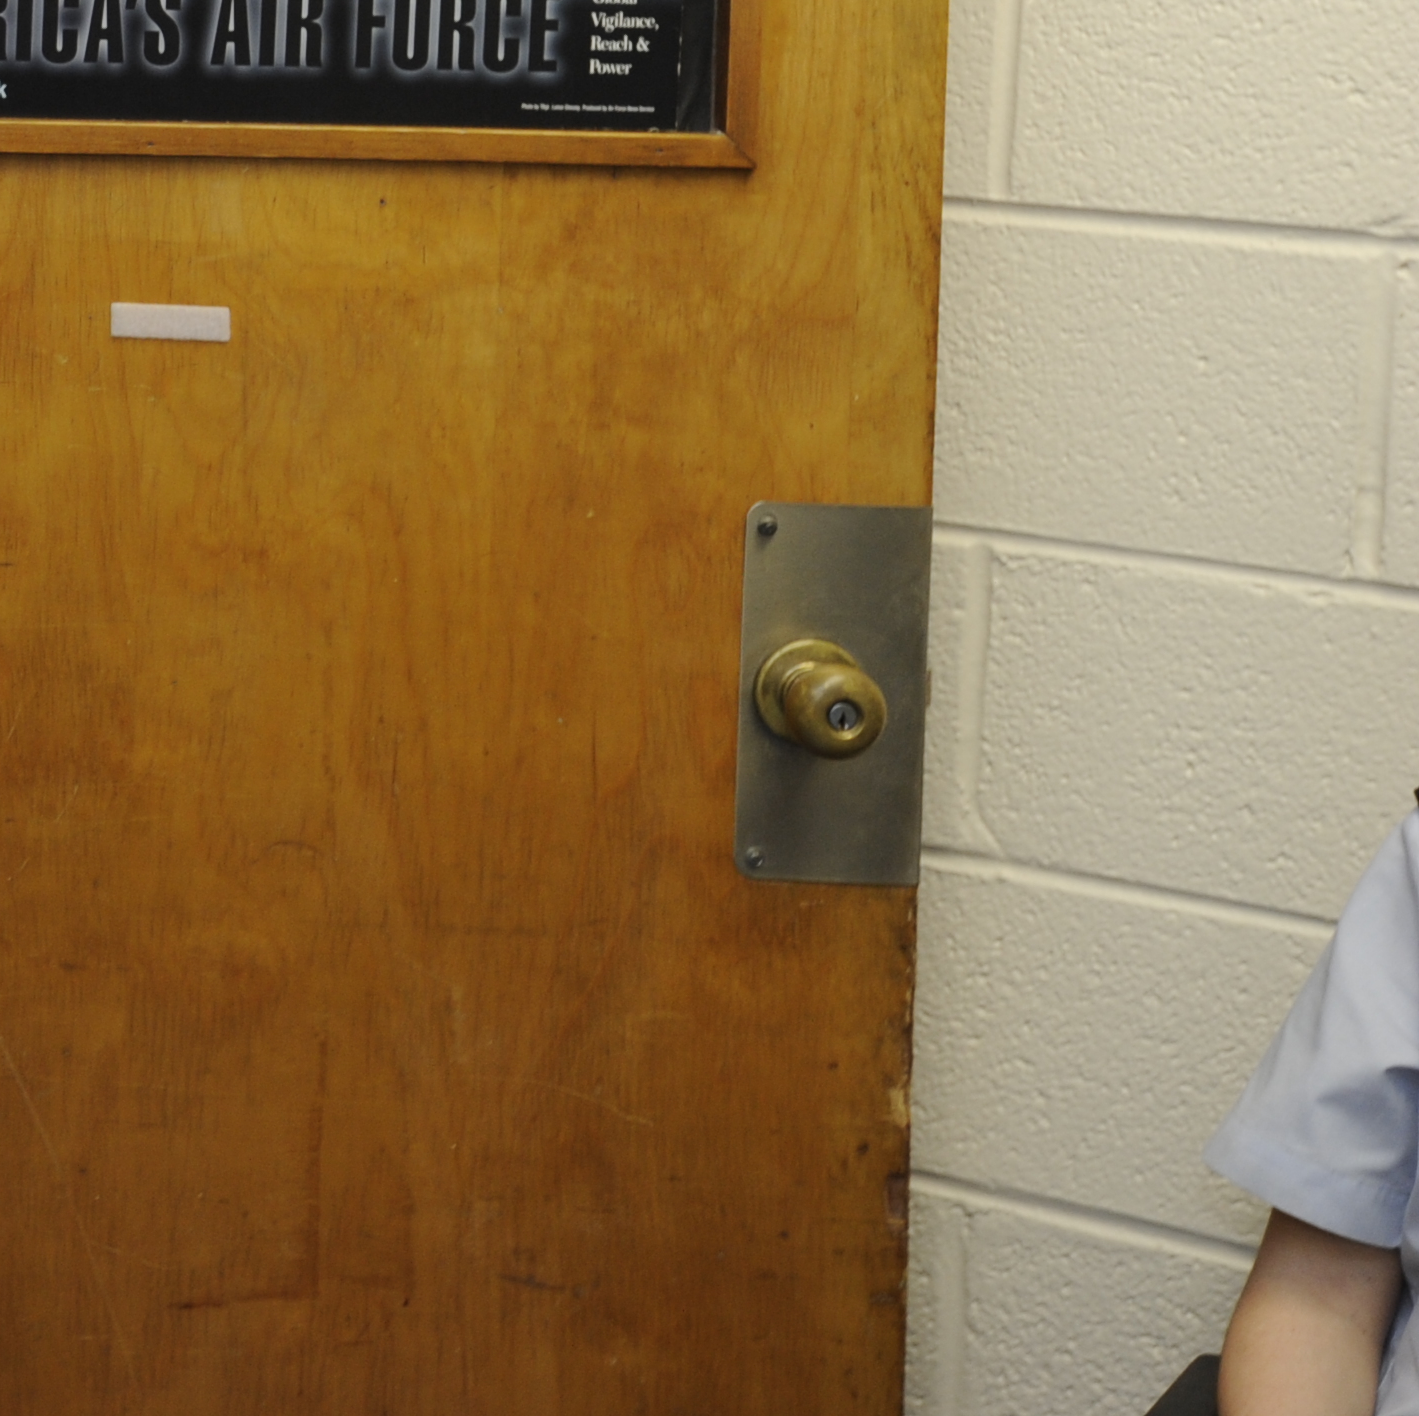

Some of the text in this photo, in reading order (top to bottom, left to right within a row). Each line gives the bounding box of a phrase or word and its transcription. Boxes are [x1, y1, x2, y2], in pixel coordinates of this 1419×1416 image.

[590, 10, 660, 33] Vigilance,
[589, 34, 651, 53] Reach &
[588, 58, 633, 76] Power
